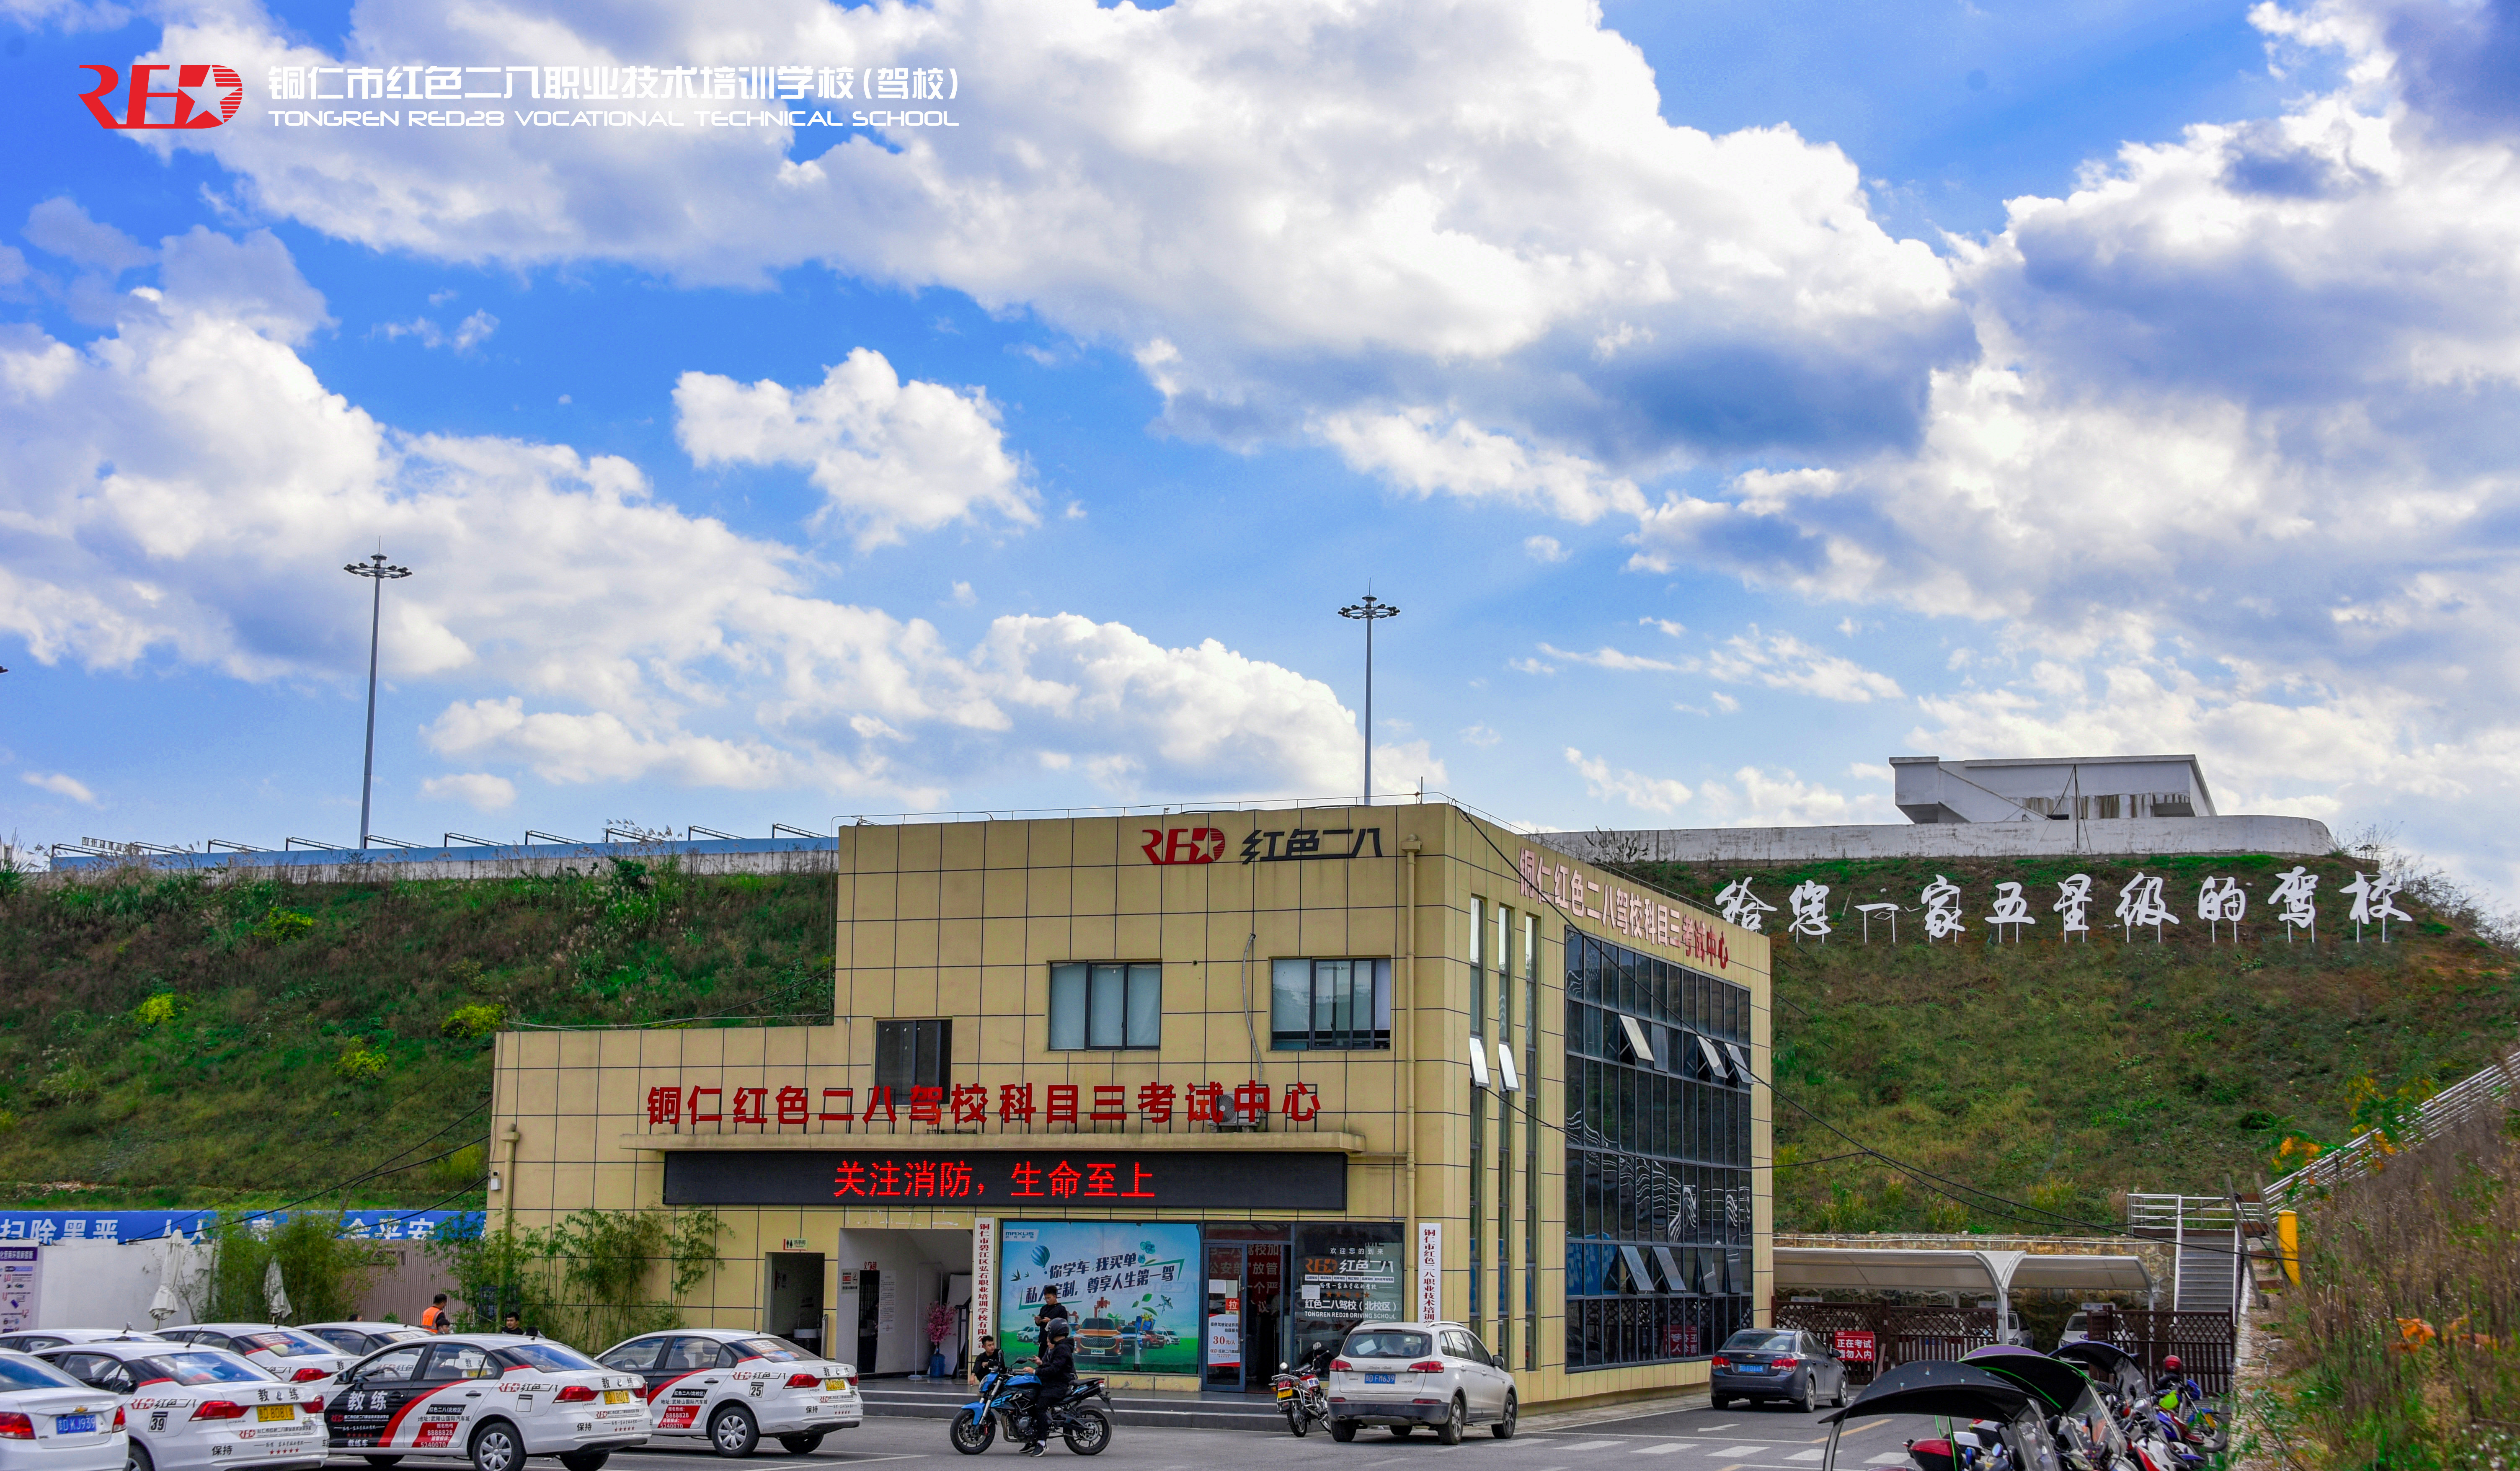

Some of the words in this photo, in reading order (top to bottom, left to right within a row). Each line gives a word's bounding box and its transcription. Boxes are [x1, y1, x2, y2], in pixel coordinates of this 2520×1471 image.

[1141, 828, 1226, 865] RED
[1239, 827, 1383, 865] 红色二八
[1518, 846, 1730, 969] 铜仁红色二八驾校科目三考试中心
[1714, 865, 2413, 938] 给您一家五星级的驾校
[647, 1081, 1321, 1125] 铜仁红色二八驾校科目三考试中心
[834, 1161, 1155, 1198] 关注消防，生命至上
[1095, 1252, 1137, 1272] 我买单
[1305, 1258, 1337, 1273] RED
[1339, 1259, 1394, 1273] 红色二八
[1229, 1300, 1237, 1310] 拉
[1305, 1299, 1396, 1311] 红色二八驾校（北校区）
[1837, 1339, 1872, 1348] 正在考试
[752, 1371, 787, 1380] 红色二八
[520, 1383, 559, 1392] 红色二八
[602, 1377, 611, 1389] 教
[258, 1388, 270, 1402] 教
[751, 1386, 762, 1396] 25
[154, 1398, 198, 1410] 红色二八
[150, 1418, 164, 1431] 39
[577, 1422, 592, 1432] 保持
[212, 1445, 233, 1456] 保持
